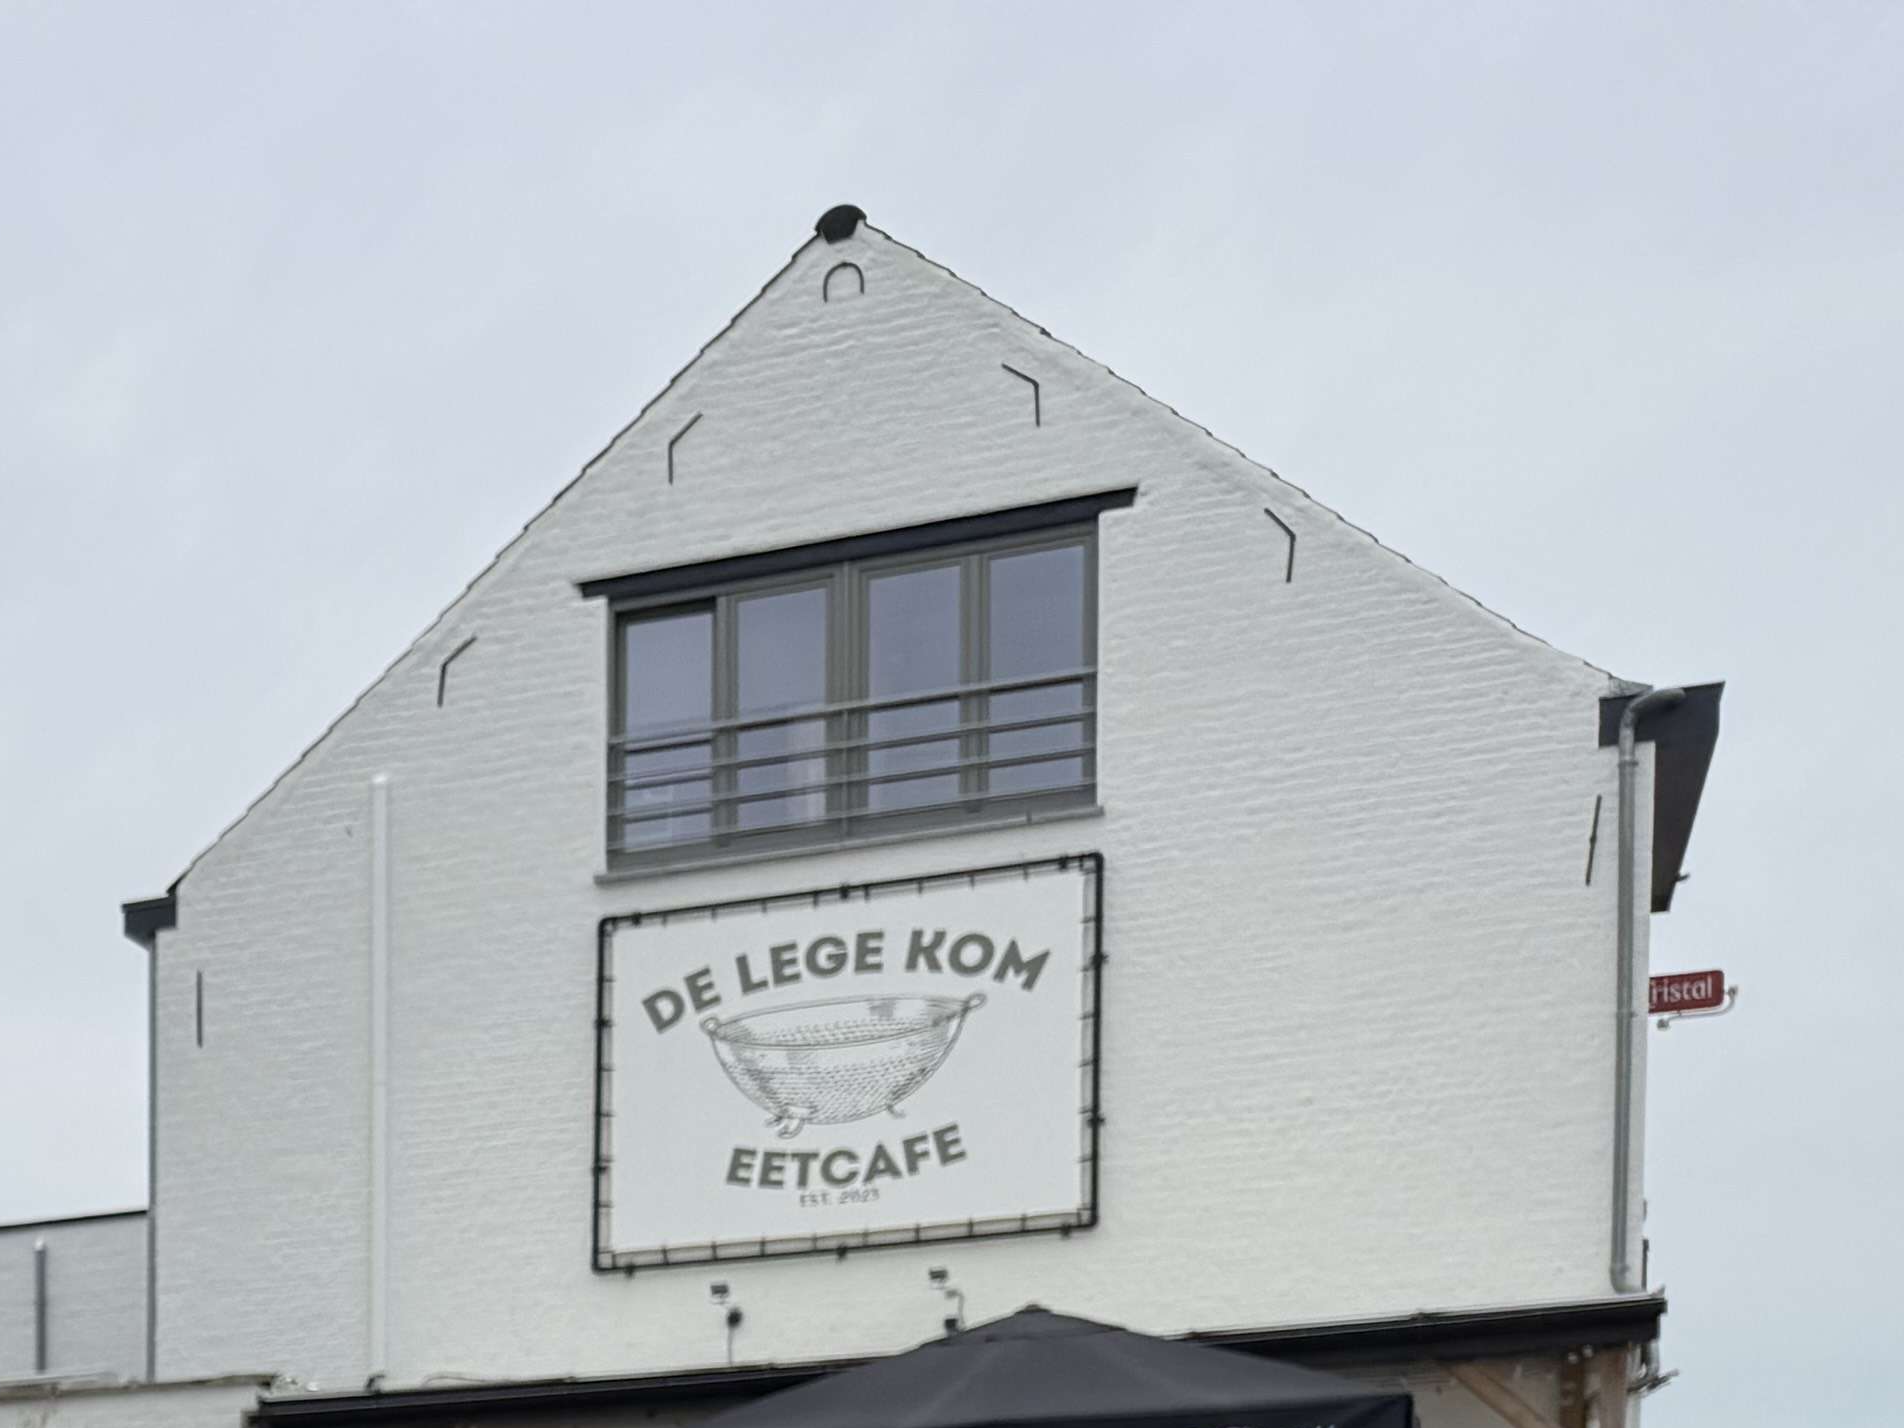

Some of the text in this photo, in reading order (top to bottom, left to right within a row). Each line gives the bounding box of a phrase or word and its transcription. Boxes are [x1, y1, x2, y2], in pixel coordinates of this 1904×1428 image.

[641, 929, 1051, 1034] DE LEGE KOM
[1648, 975, 1714, 1008] ristal
[725, 1124, 967, 1188] EETCAFE
